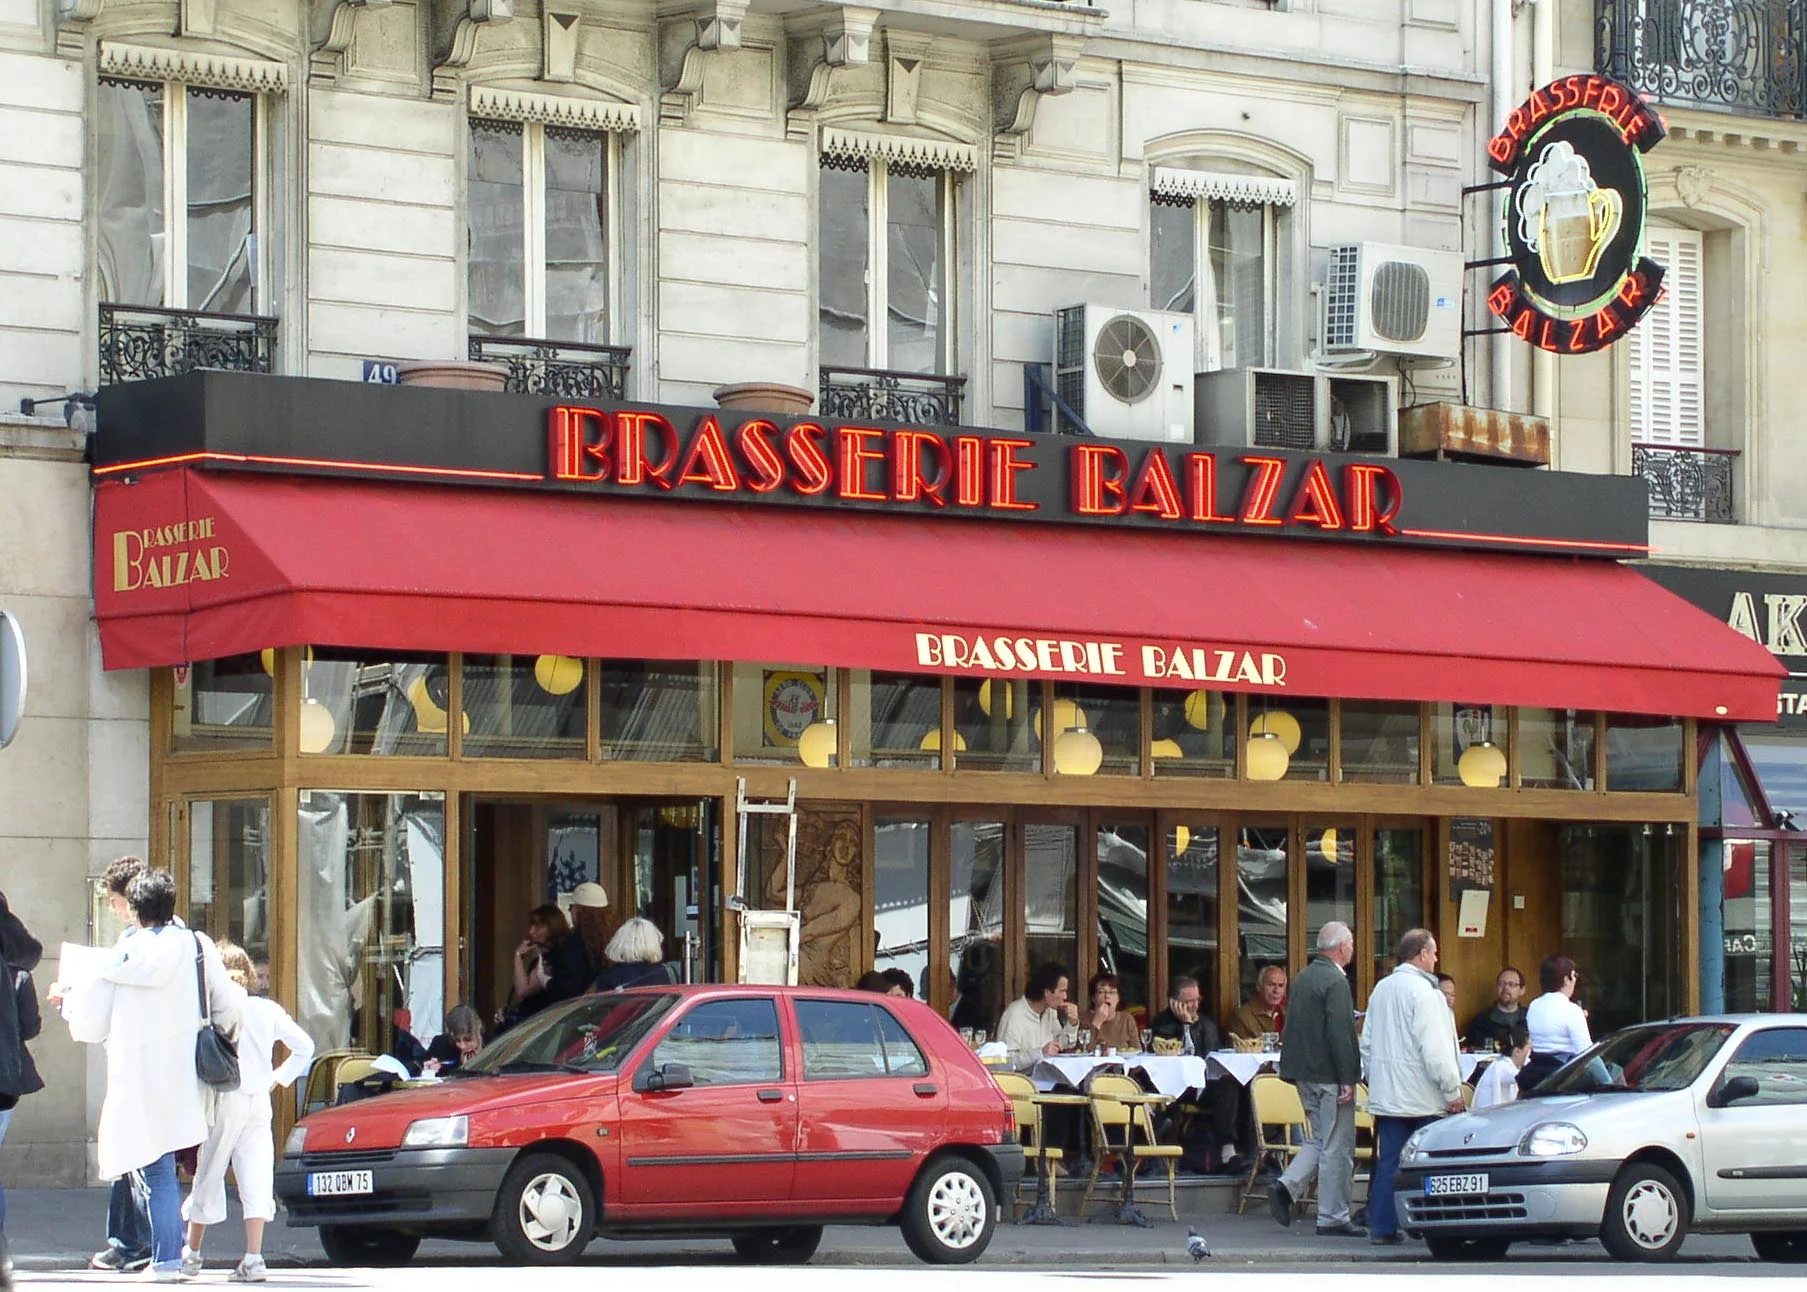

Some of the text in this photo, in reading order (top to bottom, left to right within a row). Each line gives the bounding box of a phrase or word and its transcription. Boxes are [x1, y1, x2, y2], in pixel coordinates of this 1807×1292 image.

[1487, 274, 1642, 351] BALZAR
[368, 363, 397, 385] 49
[550, 407, 1403, 535] BRASSERIE BALZAR
[113, 530, 230, 592] BALZAR
[915, 633, 1287, 687] BRASSERIE BALZAR
[316, 1172, 369, 1193] 132 QBM 75
[1430, 1176, 1483, 1194] 625 EBZ 91
